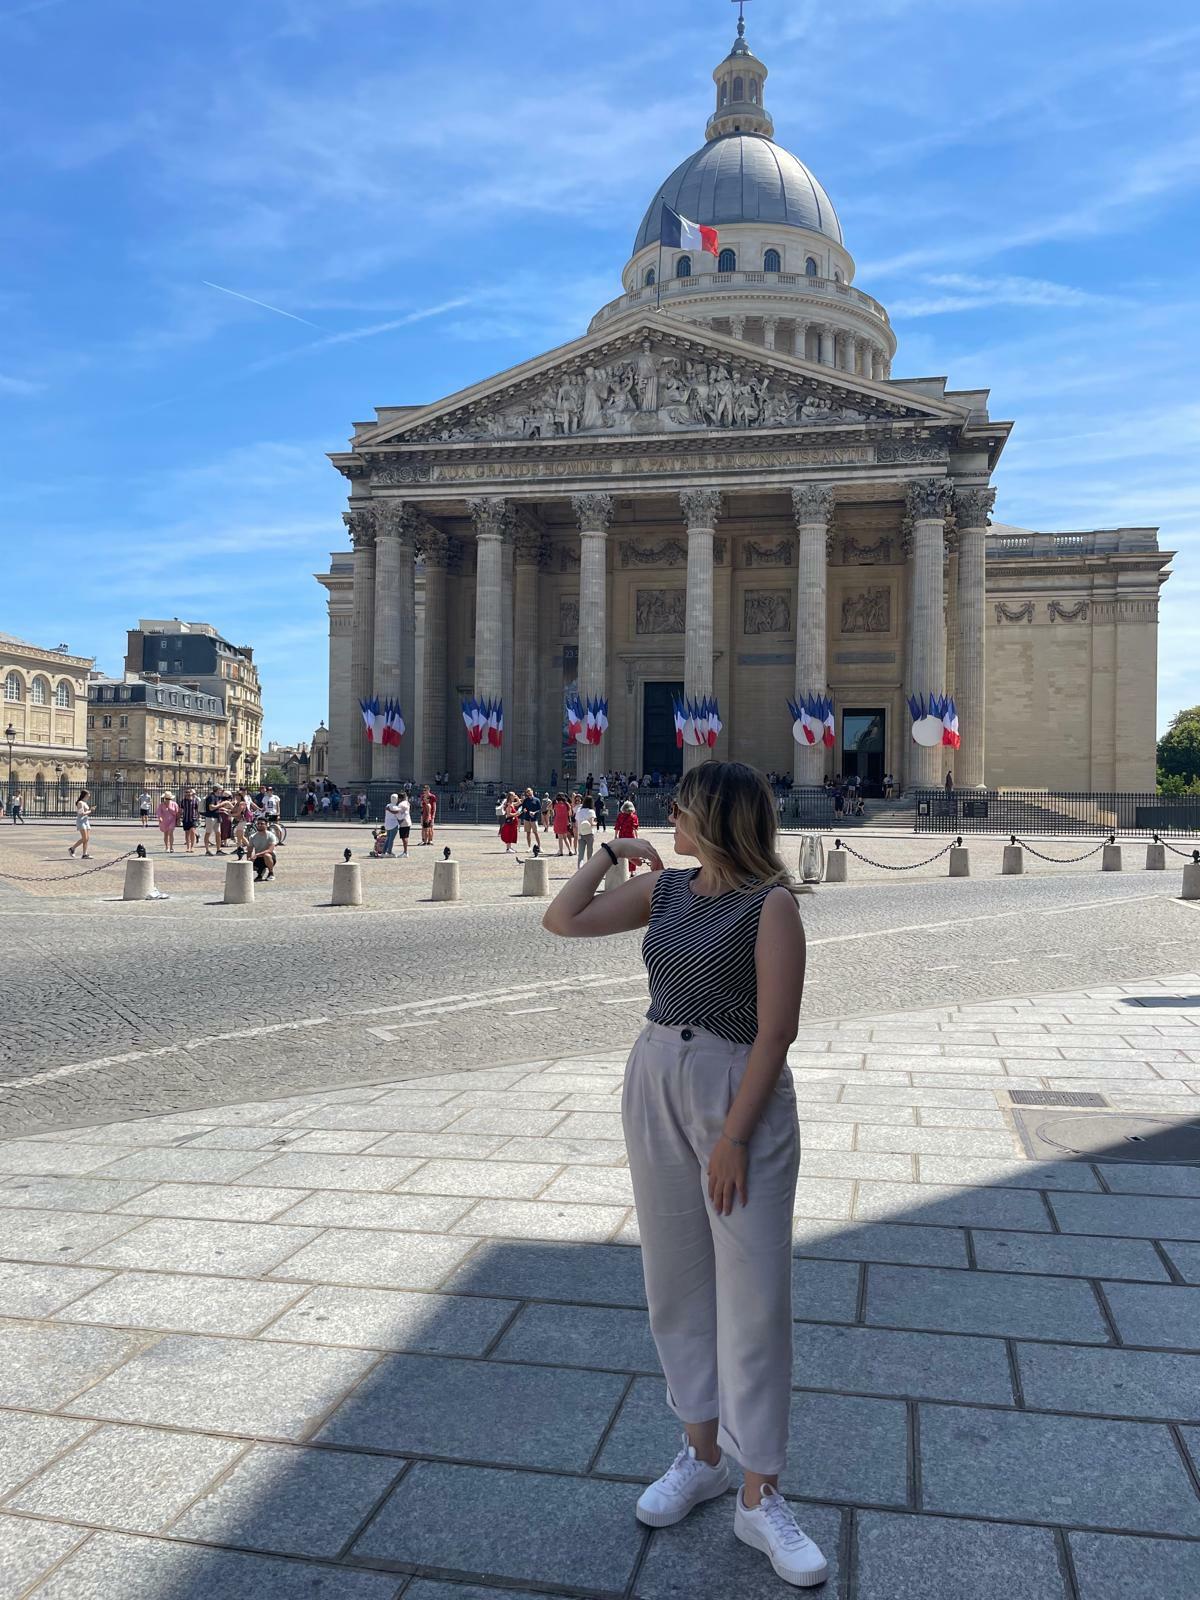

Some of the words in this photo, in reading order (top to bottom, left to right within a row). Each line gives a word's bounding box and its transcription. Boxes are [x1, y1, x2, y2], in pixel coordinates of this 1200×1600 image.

[437, 464, 468, 479] AUX
[475, 462, 541, 478] GRANDS
[544, 459, 612, 475] HOMMES
